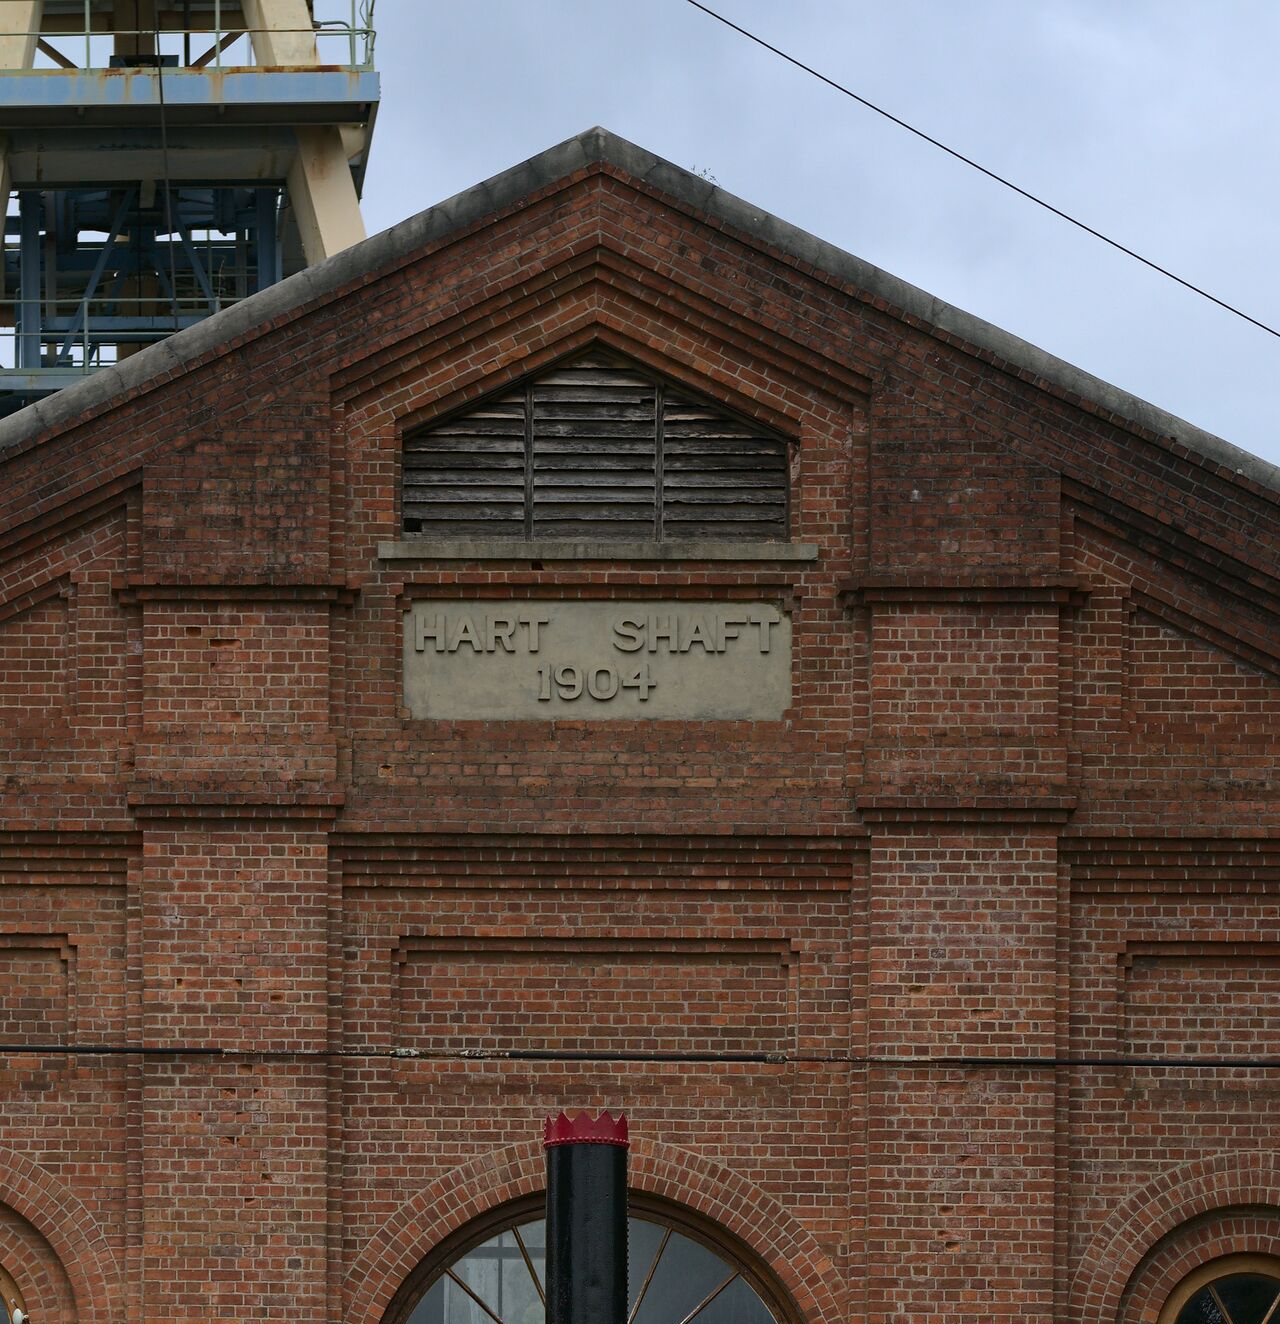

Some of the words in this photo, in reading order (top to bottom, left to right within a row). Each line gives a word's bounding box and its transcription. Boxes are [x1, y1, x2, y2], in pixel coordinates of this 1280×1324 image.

[414, 613, 549, 653] HART
[612, 613, 781, 653] SHAFT
[536, 662, 657, 701] 1904
